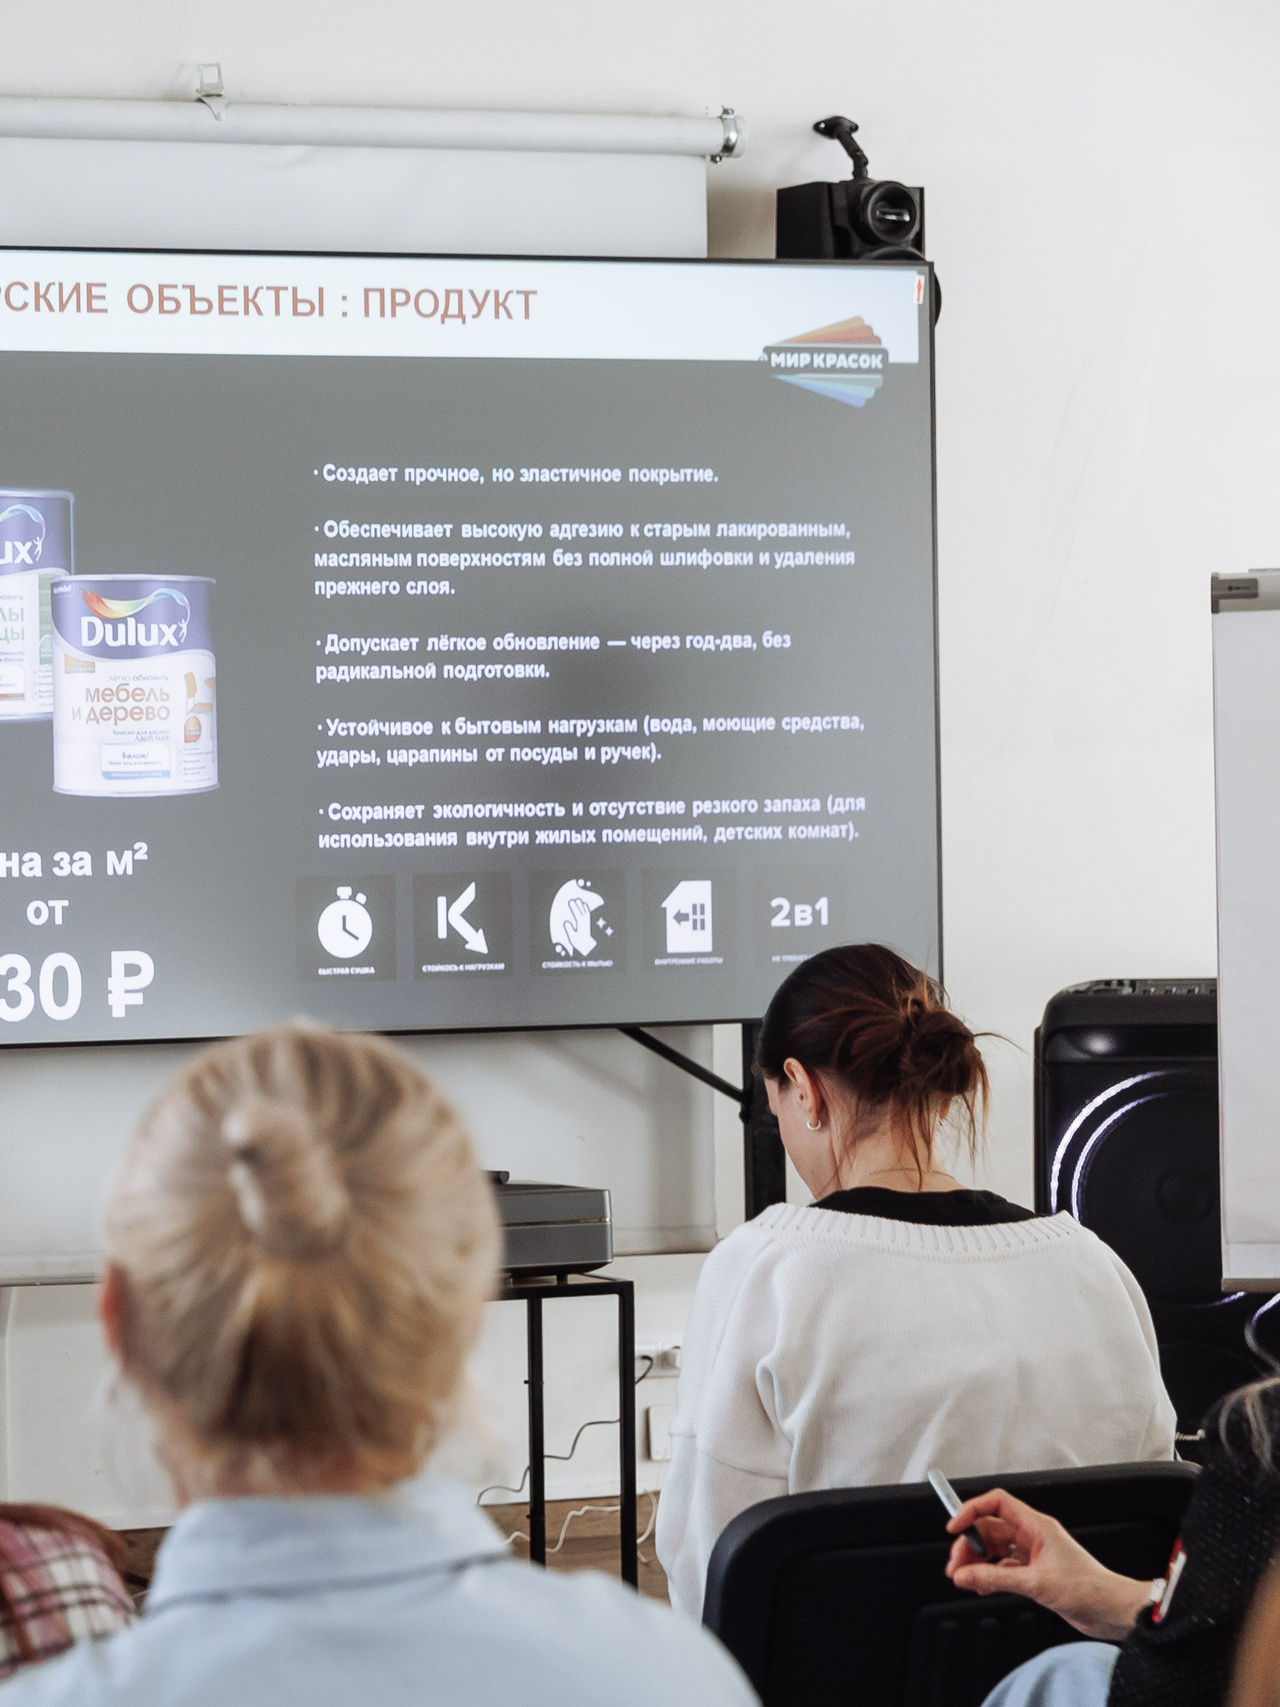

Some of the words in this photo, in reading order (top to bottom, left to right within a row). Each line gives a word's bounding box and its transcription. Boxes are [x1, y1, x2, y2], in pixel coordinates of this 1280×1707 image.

[127, 284, 324, 317] ОБЪЕКТЫ
[342, 294, 348, 318] :
[364, 288, 537, 324] ПРОДУКТ
[771, 351, 812, 368] МИР
[813, 353, 882, 369] КРАСОК
[323, 464, 398, 484] Создает
[405, 468, 484, 485] прочное,
[493, 468, 514, 482] но
[520, 468, 621, 482] эластичное
[629, 469, 718, 485] покрытие.
[324, 520, 453, 538] Обеспечивает
[462, 524, 542, 541] высокую
[550, 524, 623, 540] адгезию
[631, 524, 639, 537] к
[644, 524, 710, 541] старым
[717, 523, 850, 540] лакированным,
[315, 553, 411, 566] масляным
[417, 553, 545, 570] поверхностям
[553, 549, 582, 566] без
[589, 550, 653, 566] полной
[660, 548, 753, 569] шлифовки
[759, 552, 769, 565] и
[774, 552, 855, 569] удаления
[315, 581, 400, 598] прежнего
[406, 581, 455, 594] слоя.
[81, 616, 178, 647] Dulux
[325, 634, 419, 655] Допускает
[427, 635, 486, 651] лёгкое
[493, 633, 600, 650] обновление
[631, 636, 680, 653] через
[763, 631, 791, 648] без
[316, 663, 436, 683] радикальной
[444, 664, 549, 681] подготовки.
[86, 683, 169, 703] мебель
[72, 707, 81, 720] и
[86, 706, 169, 726] дерево
[326, 719, 433, 736] Устойчивое
[442, 721, 451, 734] к
[455, 717, 541, 734] бытовым
[549, 719, 637, 737] нагрузкам
[644, 715, 697, 736] (вода,
[703, 717, 776, 733] моющие
[782, 716, 864, 733] средства,
[317, 750, 380, 768] удары,
[387, 749, 477, 766] царапины
[486, 748, 505, 761] от
[510, 747, 577, 765] посуды
[585, 747, 595, 760] и
[601, 742, 661, 764] ручек).
[328, 803, 425, 823] Сохраняет
[433, 803, 565, 818] экологичность
[572, 803, 583, 816] и
[589, 801, 686, 819] отсутствие
[693, 800, 758, 817] резкого
[764, 798, 820, 812] запаха
[827, 795, 865, 814] (для
[319, 832, 457, 848] использования
[467, 831, 529, 849] внутри
[535, 830, 596, 844] жилых
[602, 825, 707, 844] помещений,
[714, 826, 782, 843] детских
[789, 821, 858, 841] комнат).
[53, 851, 92, 876] за
[27, 900, 69, 925] от
[771, 897, 828, 926] 2в1
